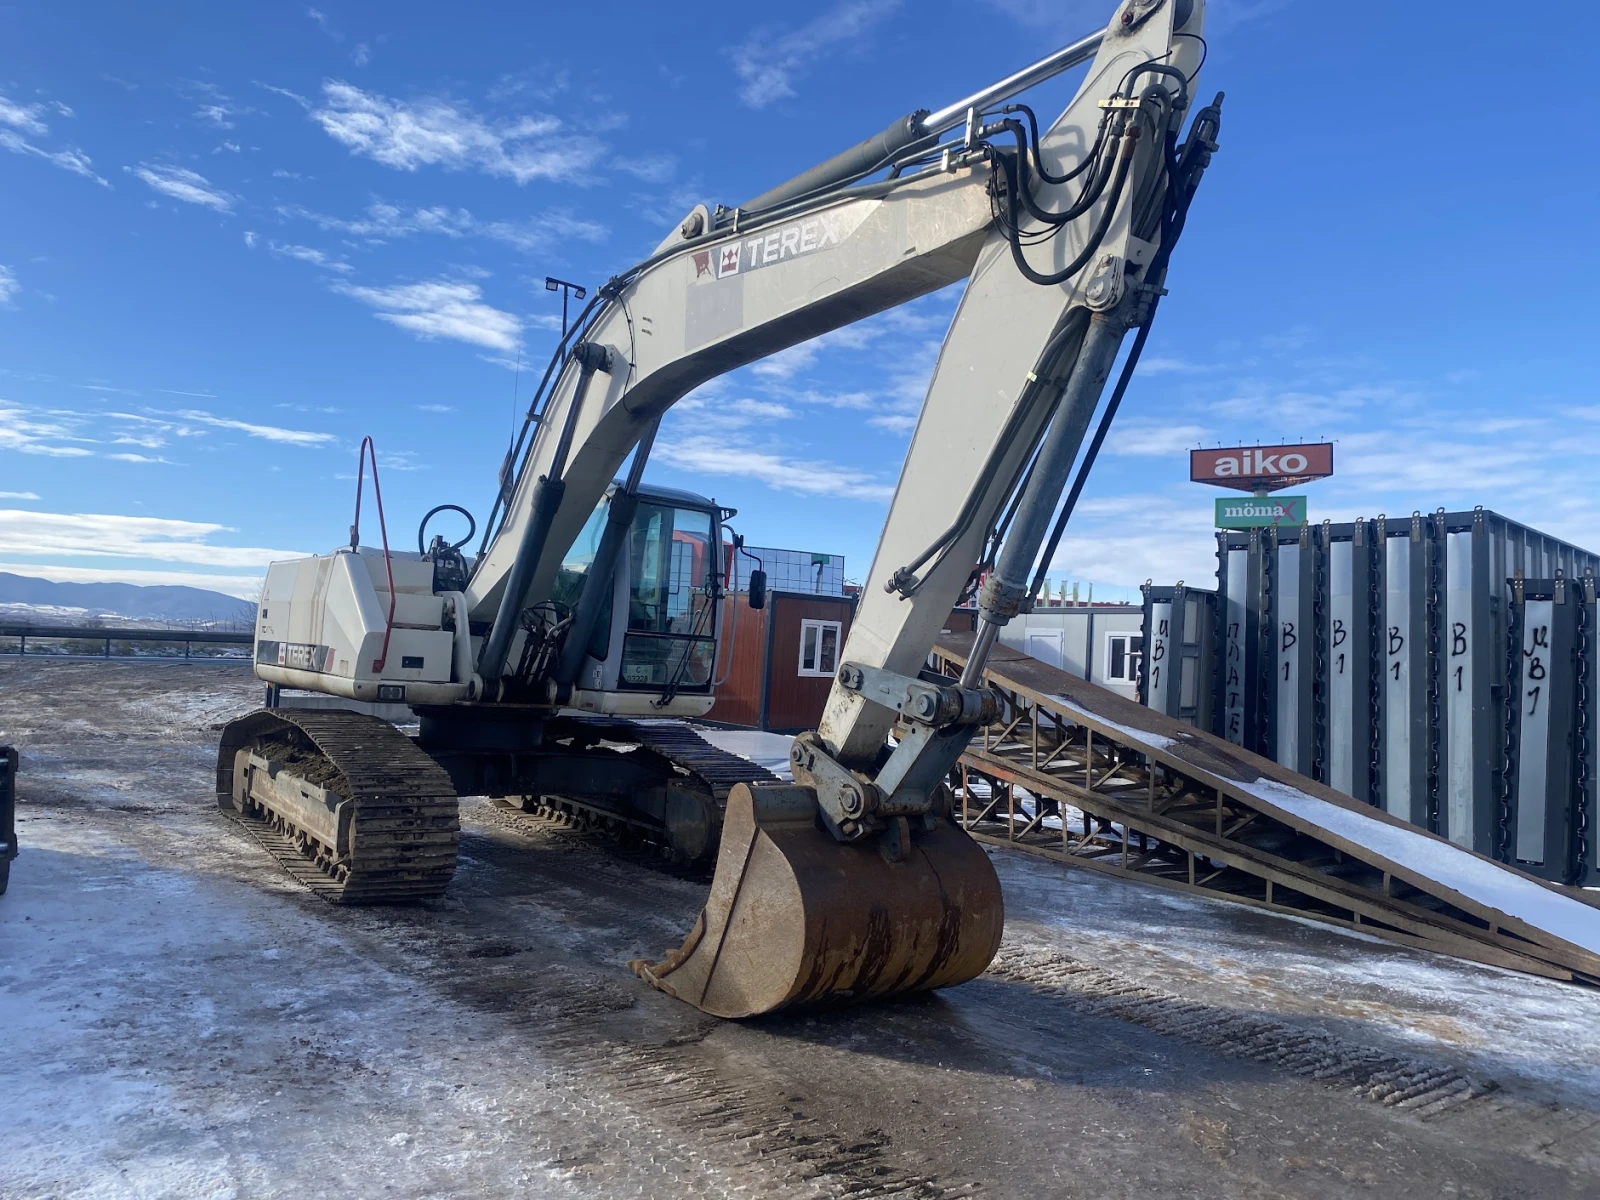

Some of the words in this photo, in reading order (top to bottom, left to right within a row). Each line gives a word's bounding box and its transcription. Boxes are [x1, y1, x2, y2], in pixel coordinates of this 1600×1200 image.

[747, 212, 839, 267] TEREX
[1214, 449, 1308, 477] aiko
[287, 644, 317, 668] TEREX
